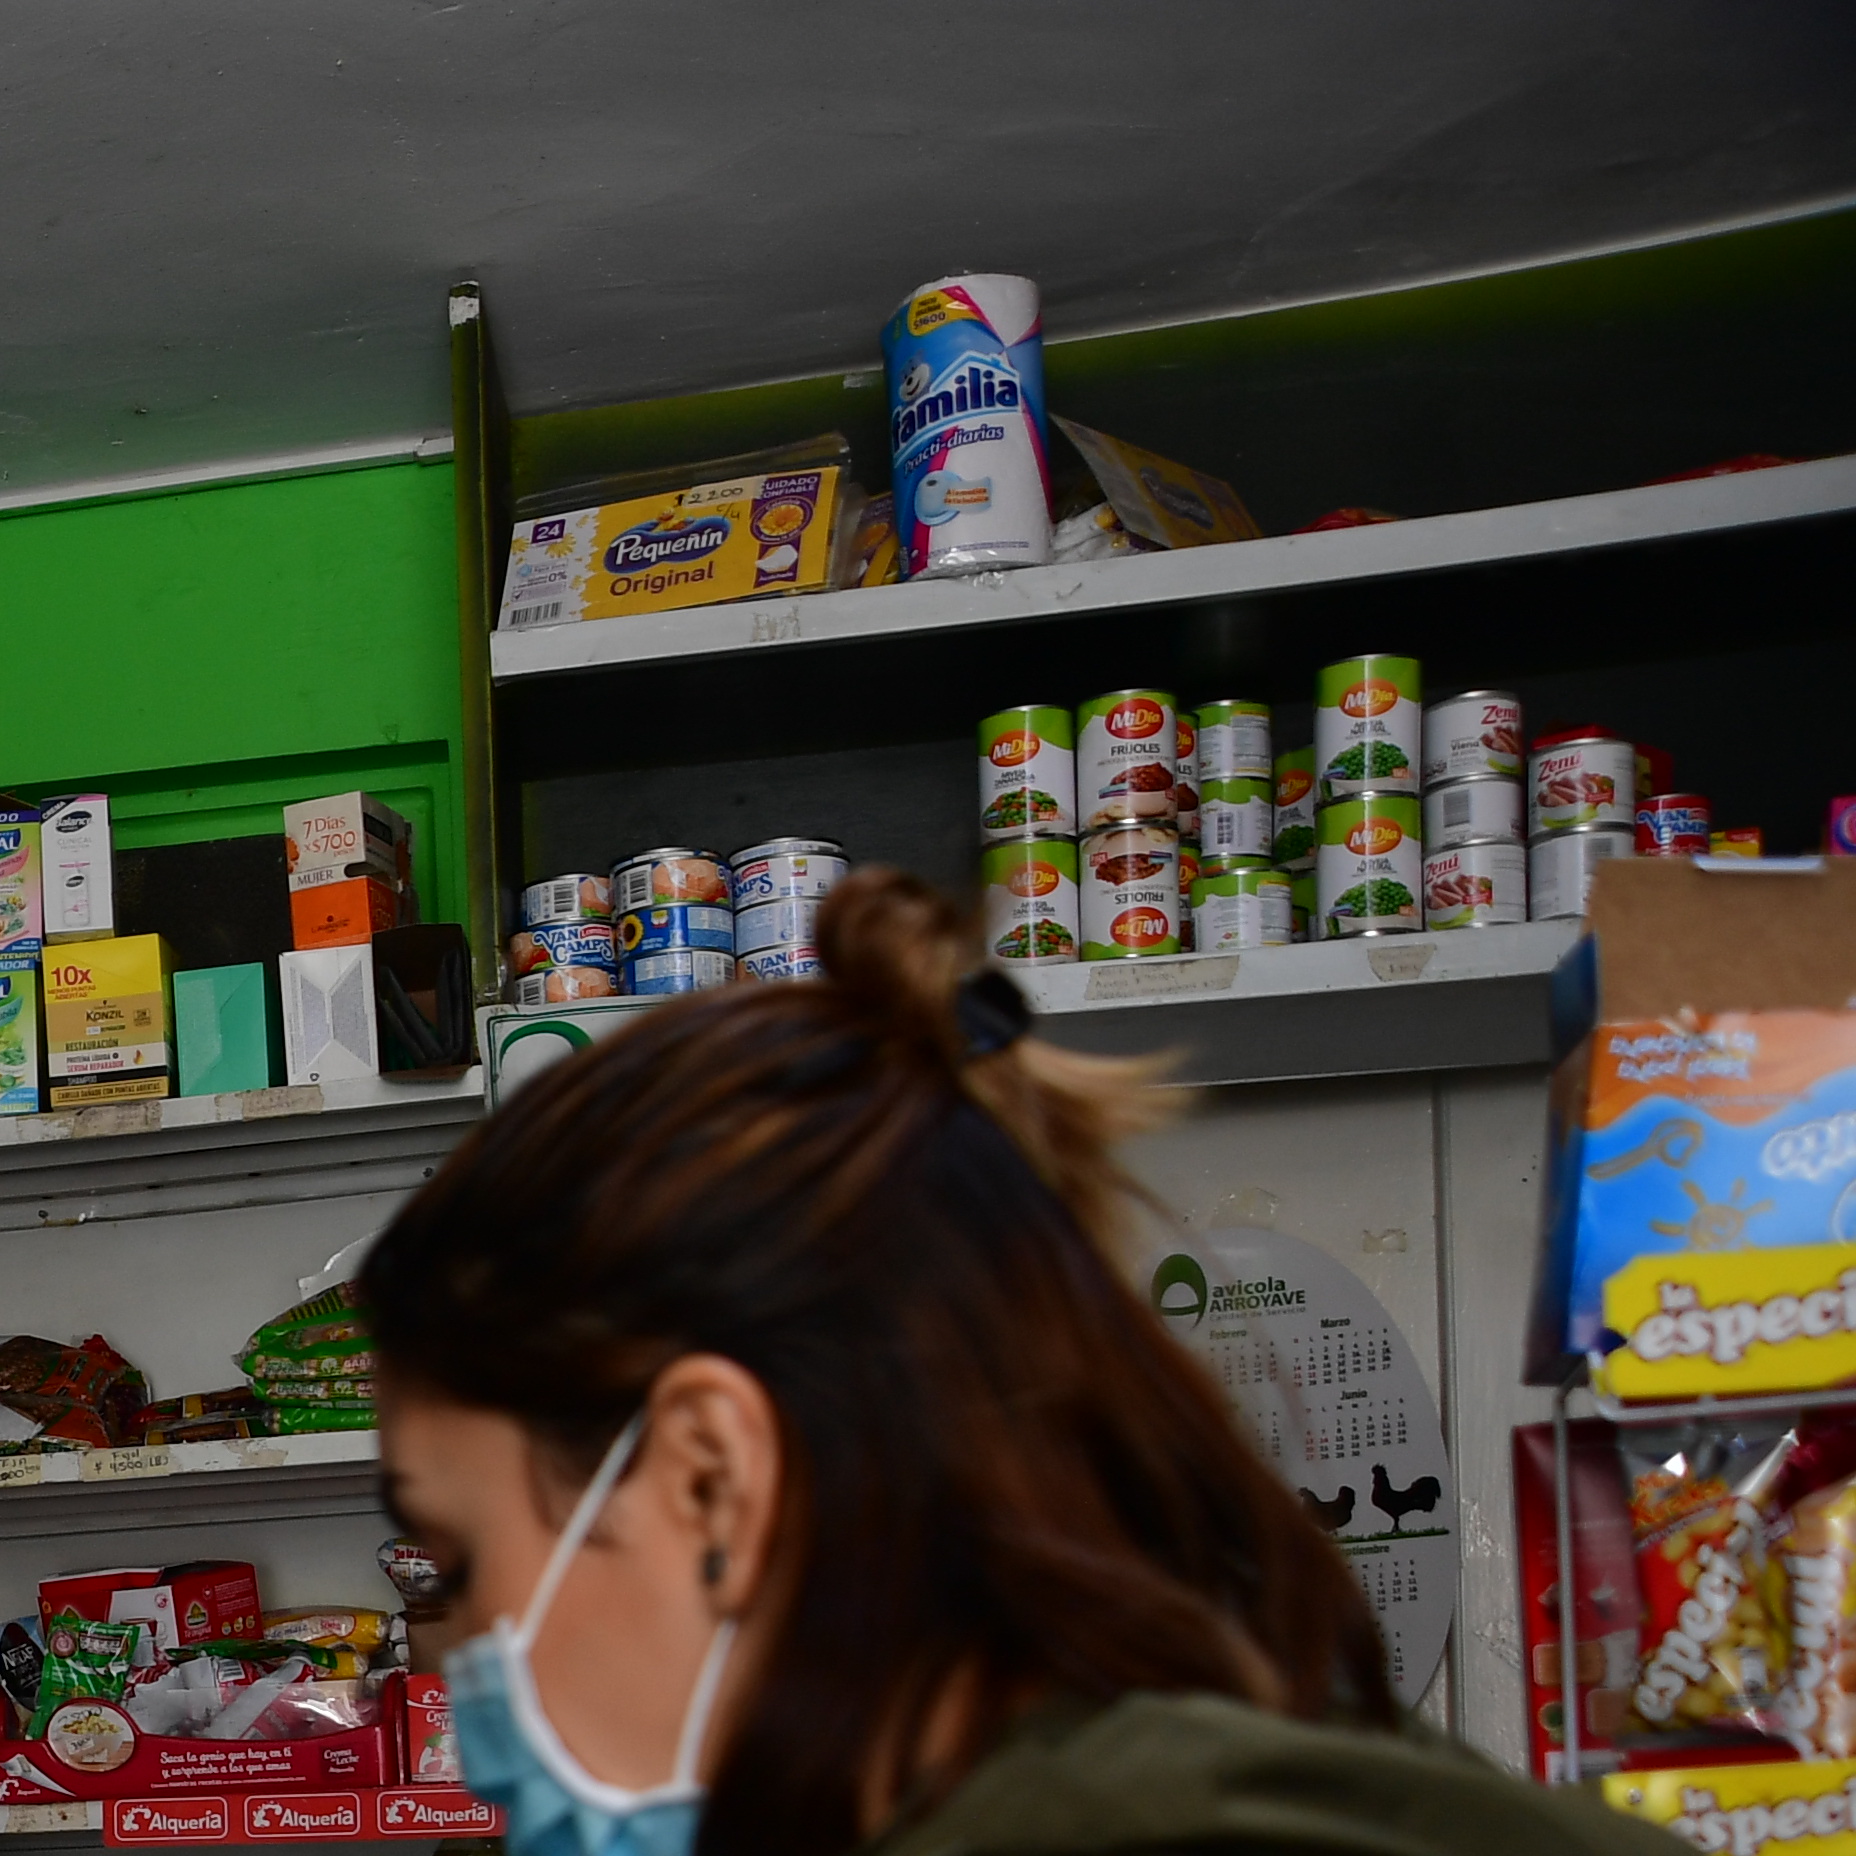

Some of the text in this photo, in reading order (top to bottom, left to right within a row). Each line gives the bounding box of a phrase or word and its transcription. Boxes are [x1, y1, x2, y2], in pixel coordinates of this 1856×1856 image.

[892, 366, 1019, 453] familia
[904, 424, 1005, 475] Practi-diarias
[537, 524, 561, 541] 24
[609, 526, 724, 567] Pequeñín
[547, 572, 567, 583] 0%
[609, 560, 716, 597] Original
[1344, 685, 1397, 710] MiDía
[1110, 706, 1163, 732] MiDía
[993, 738, 1038, 761] MiDía
[1110, 743, 1161, 757] FRÍJOLES
[1538, 751, 1583, 783] Zenú
[42, 801, 68, 821] CREMA
[302, 815, 347, 840] 7 Días
[1349, 823, 1399, 849] MiDía
[297, 869, 334, 887] MUJER
[1425, 853, 1461, 885] Zenú
[532, 929, 579, 952] VAN
[746, 950, 788, 973] VAN
[50, 965, 94, 987] 10x
[85, 1009, 125, 1023] KONZIL
[1212, 1276, 1286, 1299] avicola
[1209, 1290, 1306, 1314] ARROYAVE
[1320, 1317, 1351, 1329] Marzo
[1209, 1329, 1248, 1341] Febrero
[1340, 1388, 1368, 1402] Junio
[160, 1749, 186, 1765] Saca
[199, 1751, 227, 1767] genio
[227, 1752, 246, 1765] que
[246, 1748, 270, 1765] hay
[171, 1764, 218, 1779] sorprende
[228, 1761, 244, 1774] los
[245, 1763, 264, 1775] que
[149, 1808, 223, 1833] Alquería
[279, 1806, 354, 1830] Alquería
[413, 1801, 490, 1829] Alquería
